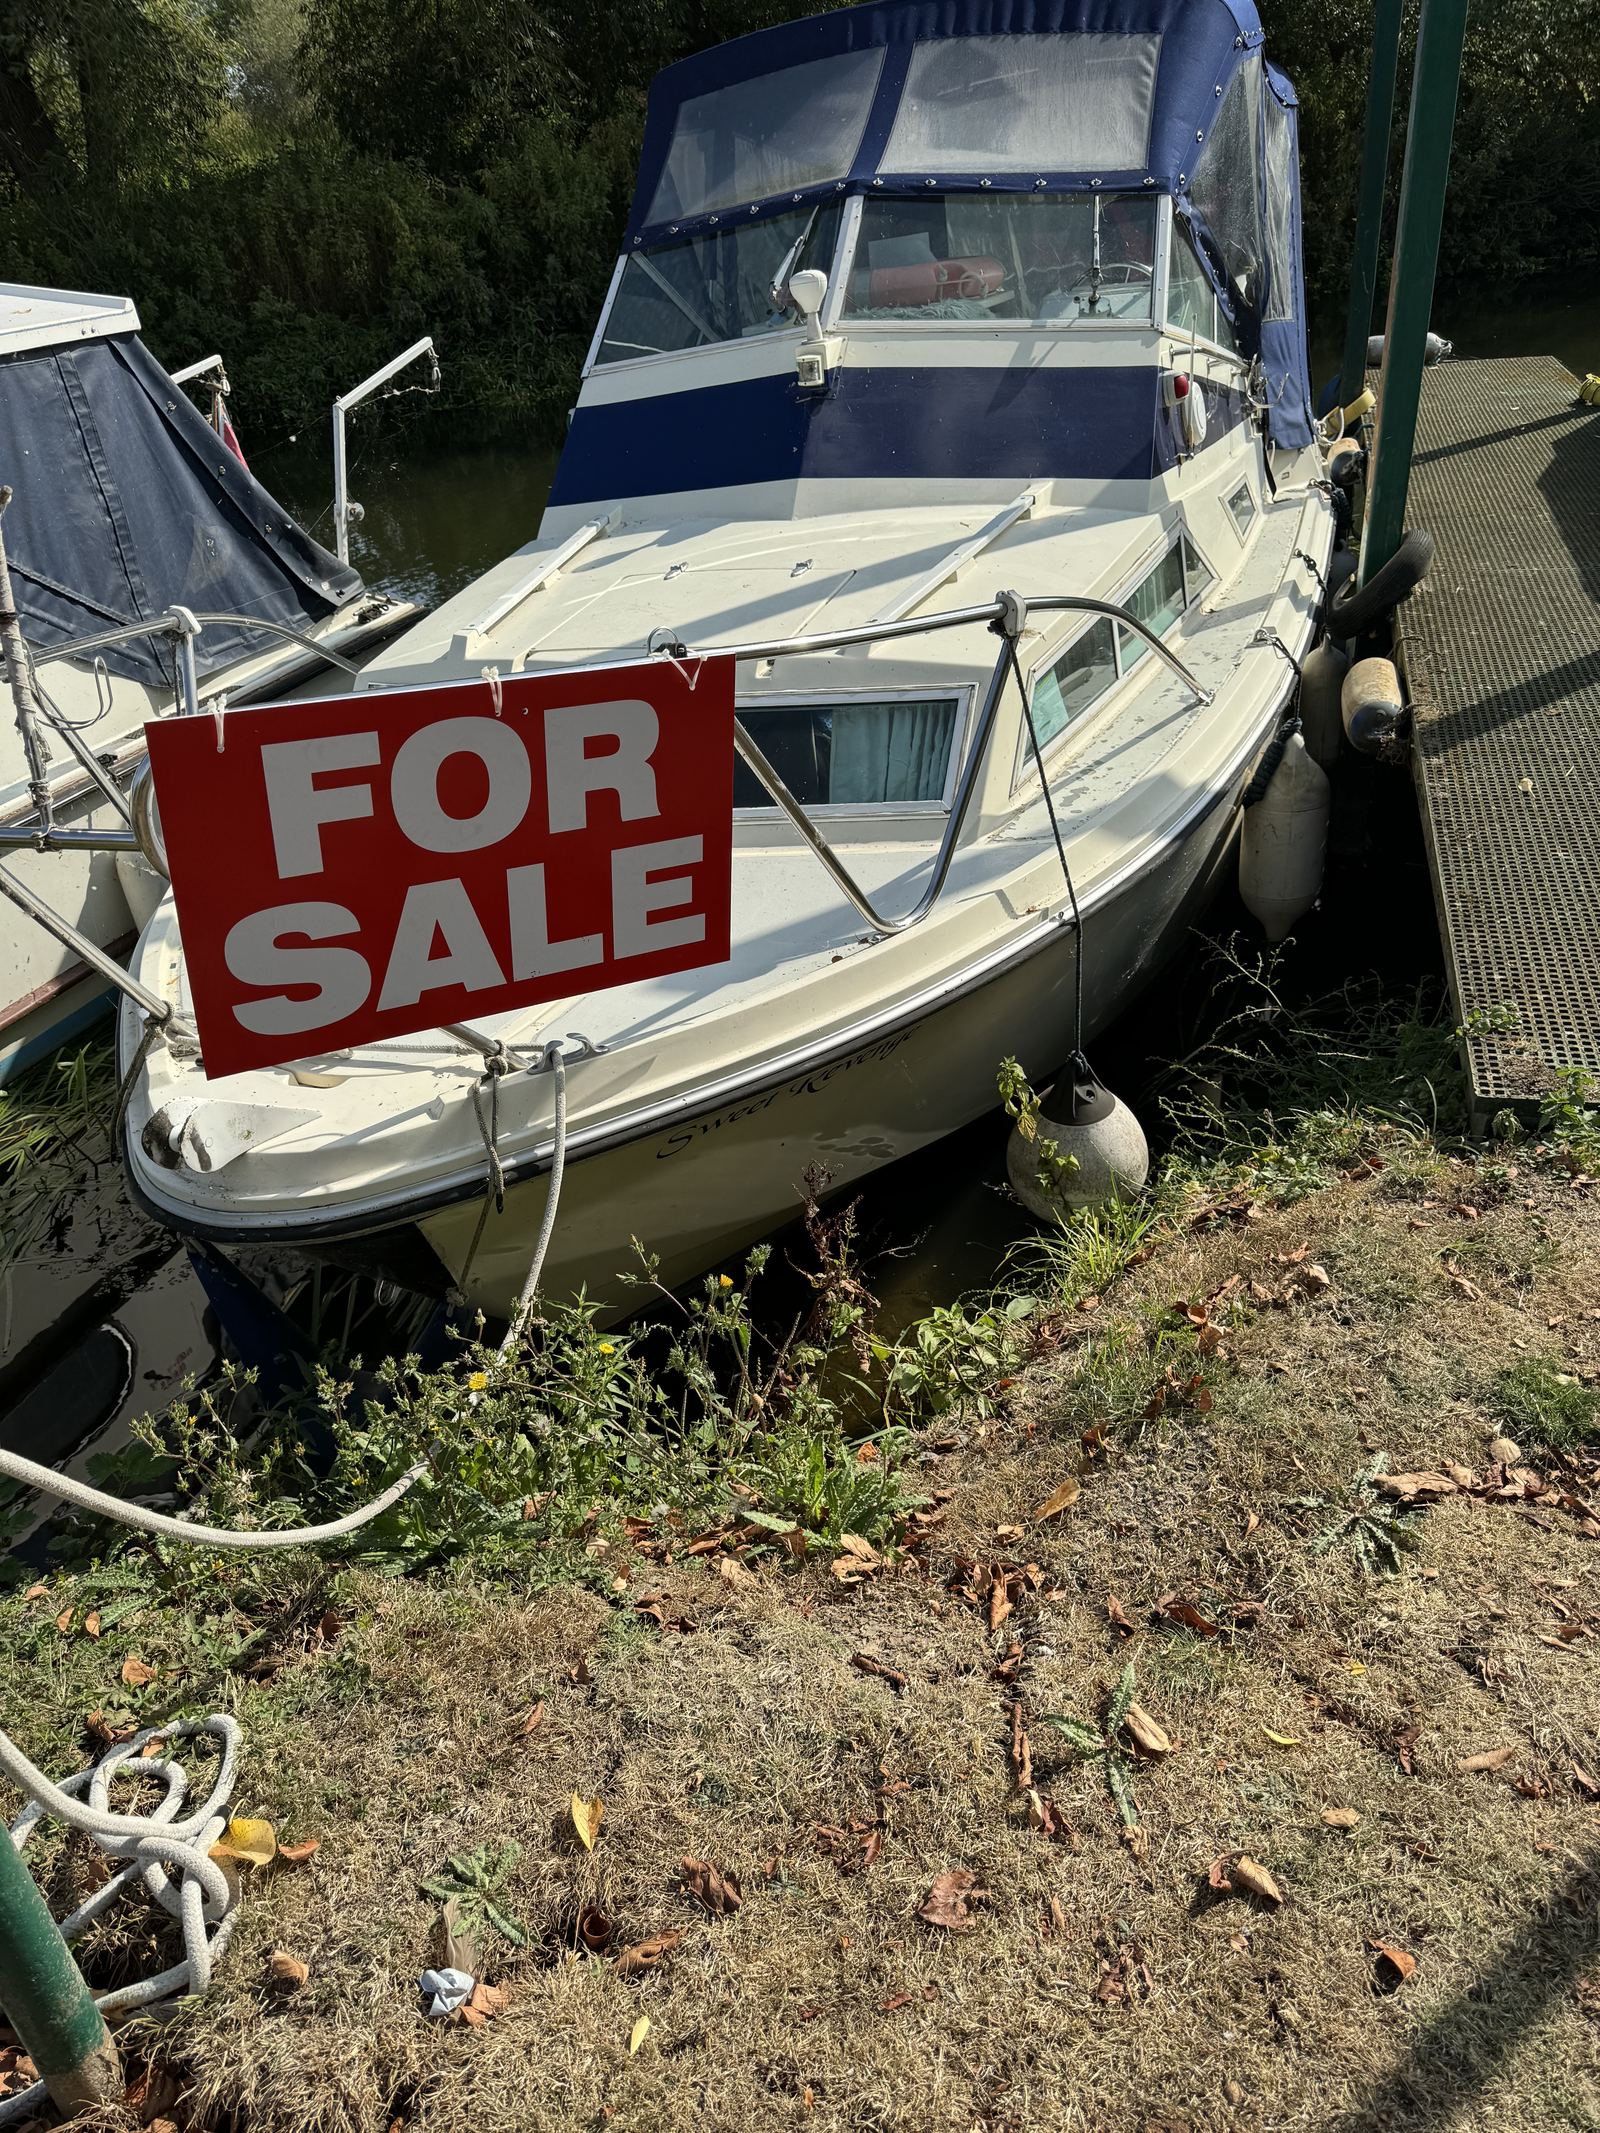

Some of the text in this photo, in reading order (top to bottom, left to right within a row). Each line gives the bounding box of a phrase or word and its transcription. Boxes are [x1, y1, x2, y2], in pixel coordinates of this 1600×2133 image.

[261, 698, 661, 880] FOR
[224, 834, 706, 1036] SALE
[656, 1024, 922, 1159] Sweet Revenge
